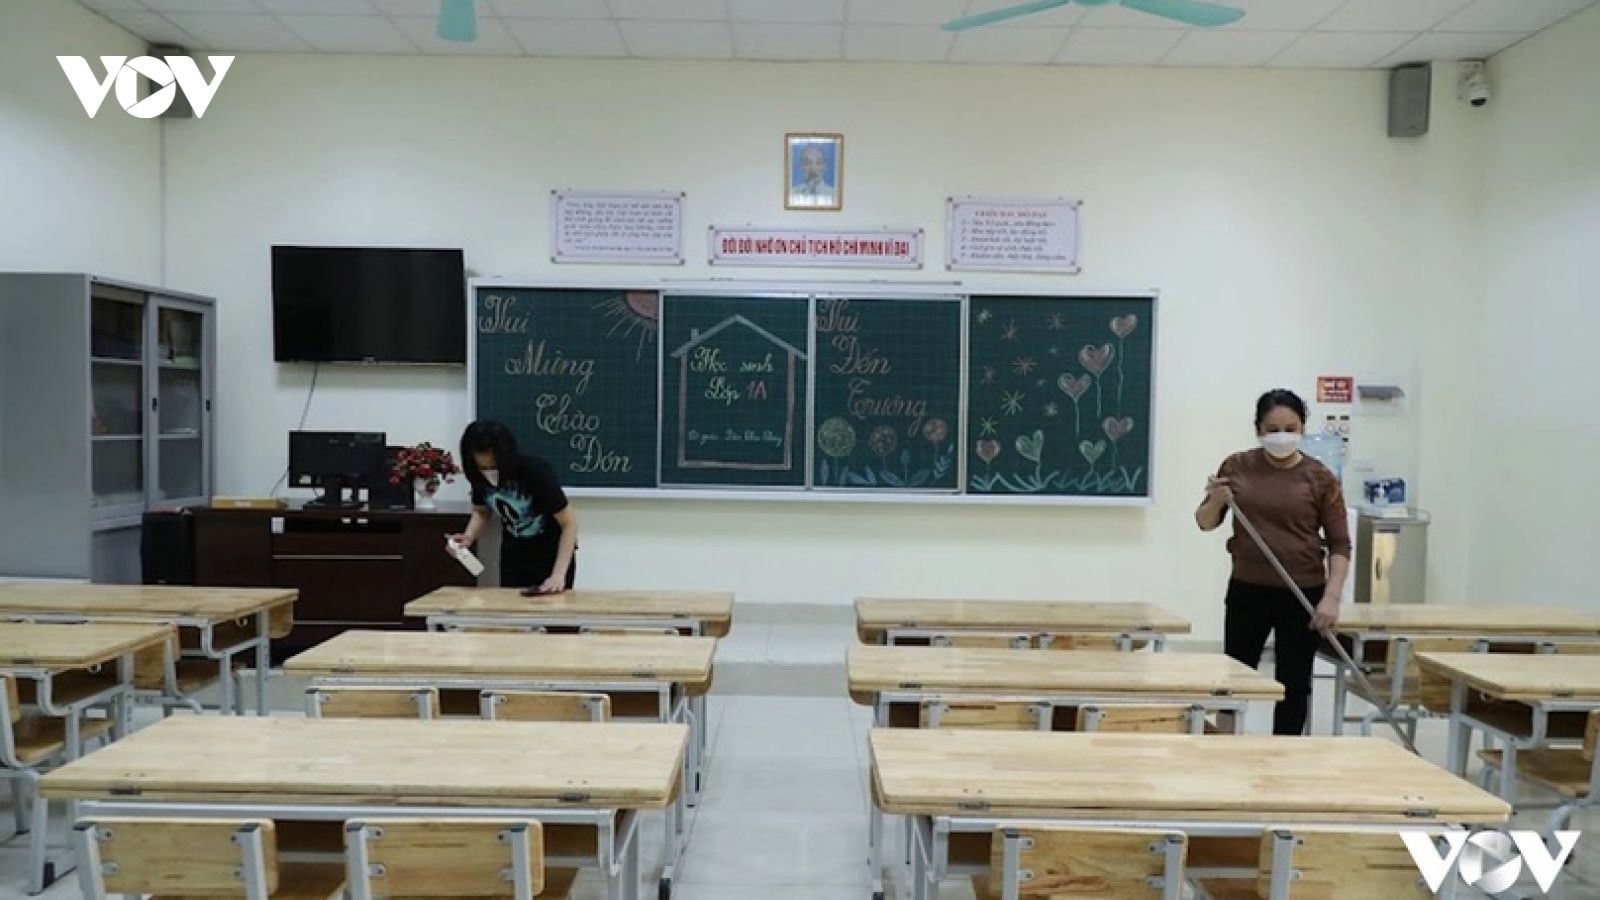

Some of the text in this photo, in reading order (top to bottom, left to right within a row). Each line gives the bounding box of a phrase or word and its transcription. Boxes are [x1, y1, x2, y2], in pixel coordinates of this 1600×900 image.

[478, 294, 531, 333] Vui
[504, 338, 595, 395] Mừng
[746, 380, 768, 400] 1A
[536, 393, 600, 434] Chào
[569, 433, 633, 473] Đón
